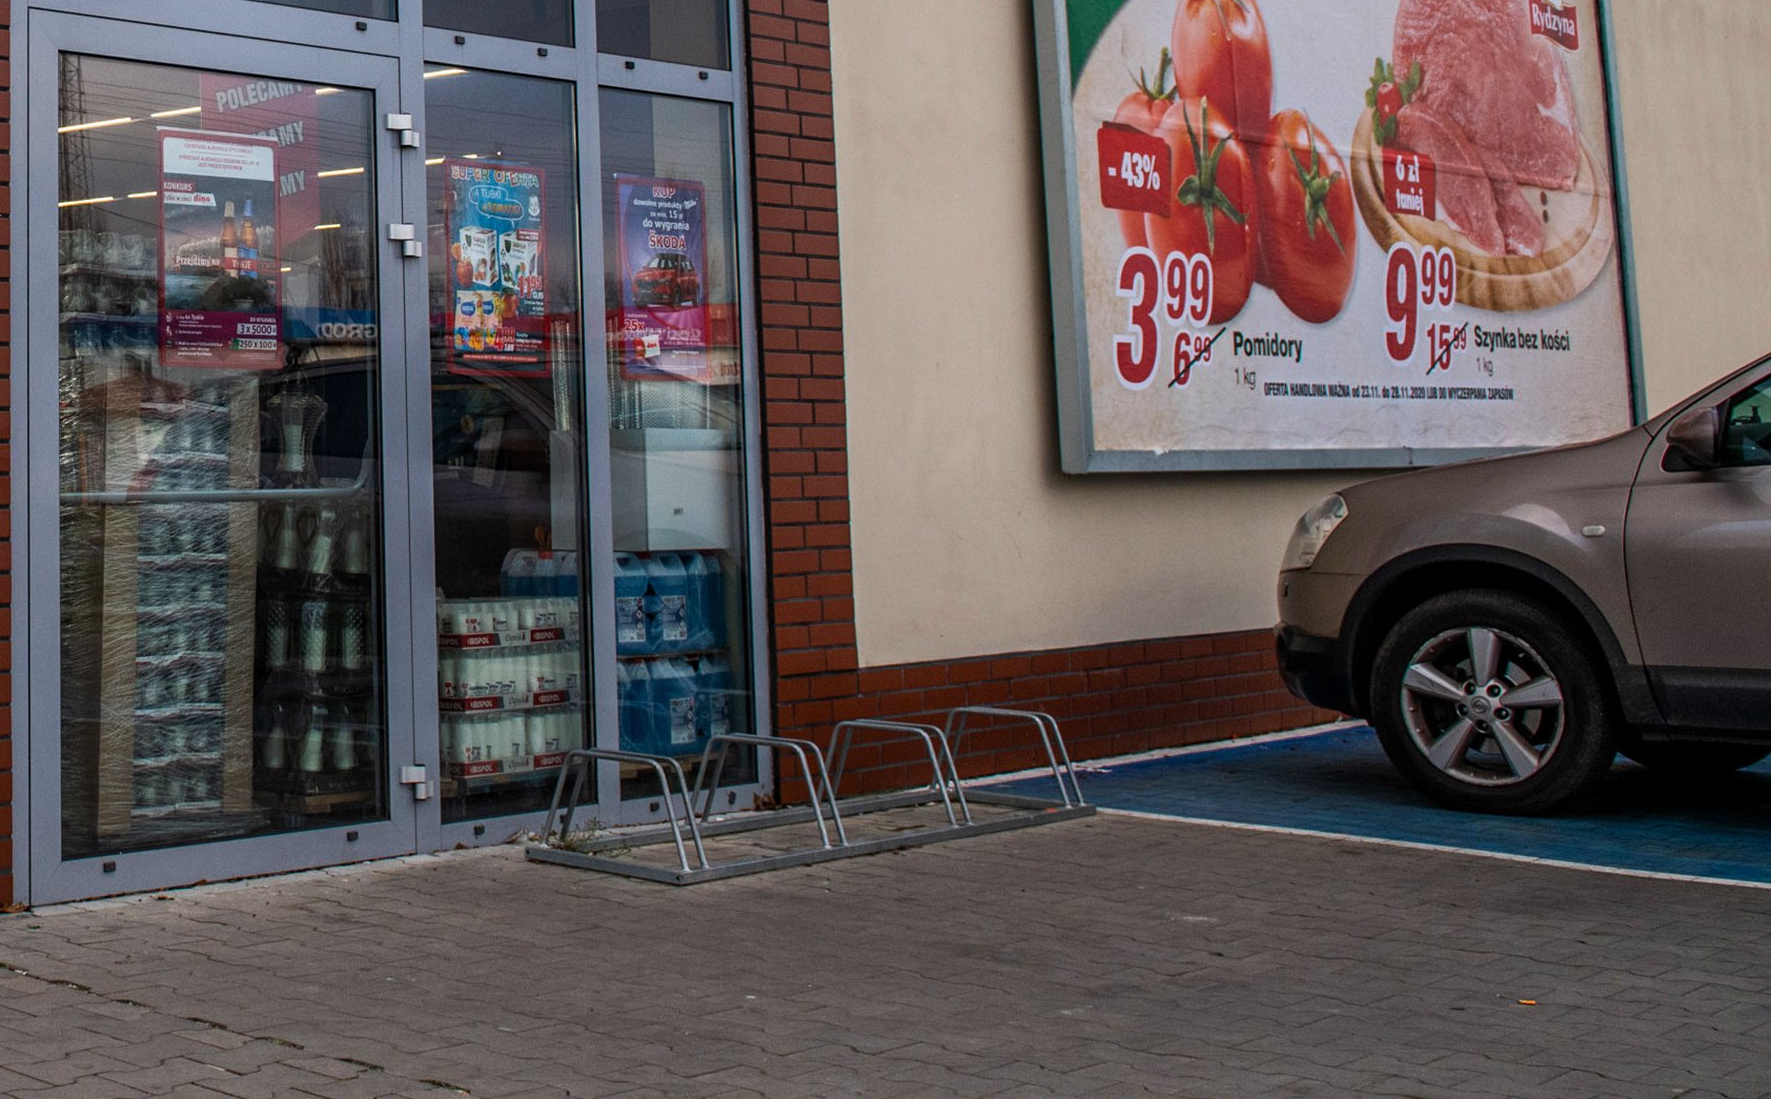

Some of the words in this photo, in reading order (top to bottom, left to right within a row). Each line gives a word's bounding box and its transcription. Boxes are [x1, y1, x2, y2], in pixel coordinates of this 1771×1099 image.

[1531, 2, 1576, 37] Rydzyna
[215, 80, 304, 113] POLECAM
[451, 165, 490, 183] SUPER
[493, 168, 540, 188] OFERTA
[1396, 187, 1424, 216] taniej
[654, 220, 690, 231] wygrania
[649, 230, 687, 250] ŠKODA
[1233, 331, 1302, 363] Pomidory
[1474, 325, 1515, 352] Szynka
[1518, 327, 1538, 349] bez
[1541, 329, 1570, 351] kości
[1243, 367, 1256, 390] kg
[1264, 382, 1289, 396] OFERTA
[1290, 383, 1327, 397] HANDLOWA
[1328, 382, 1350, 397] WAŻNA
[1352, 385, 1360, 398] od
[1361, 385, 1381, 398] 23.11.
[1427, 386, 1438, 399] LUB
[1439, 387, 1447, 399] DO
[1448, 387, 1487, 400] WYCZERPANIA
[1488, 386, 1514, 400] ZAPASÓW
